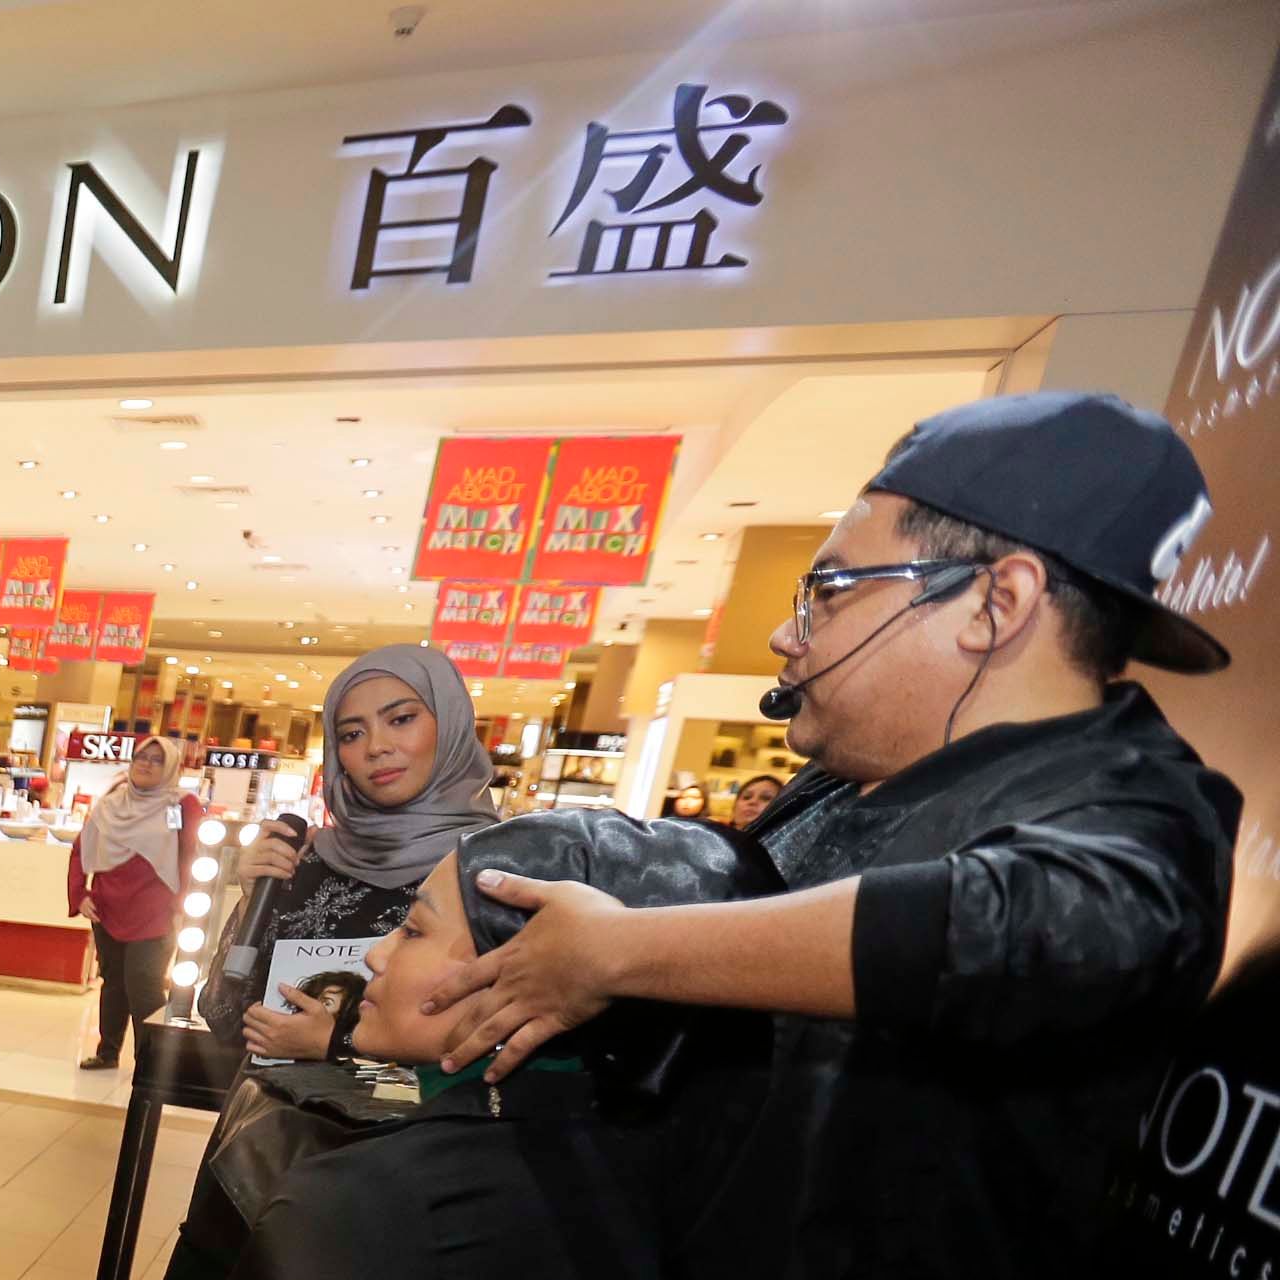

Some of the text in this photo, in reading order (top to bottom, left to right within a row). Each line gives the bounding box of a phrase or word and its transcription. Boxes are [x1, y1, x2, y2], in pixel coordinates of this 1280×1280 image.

[342, 83, 789, 291] 百盛
[463, 467, 517, 485] MAD
[583, 466, 640, 484] MAD
[446, 483, 526, 502] ABOUT
[565, 483, 648, 503] ABOUT
[296, 945, 361, 957] NOTE
